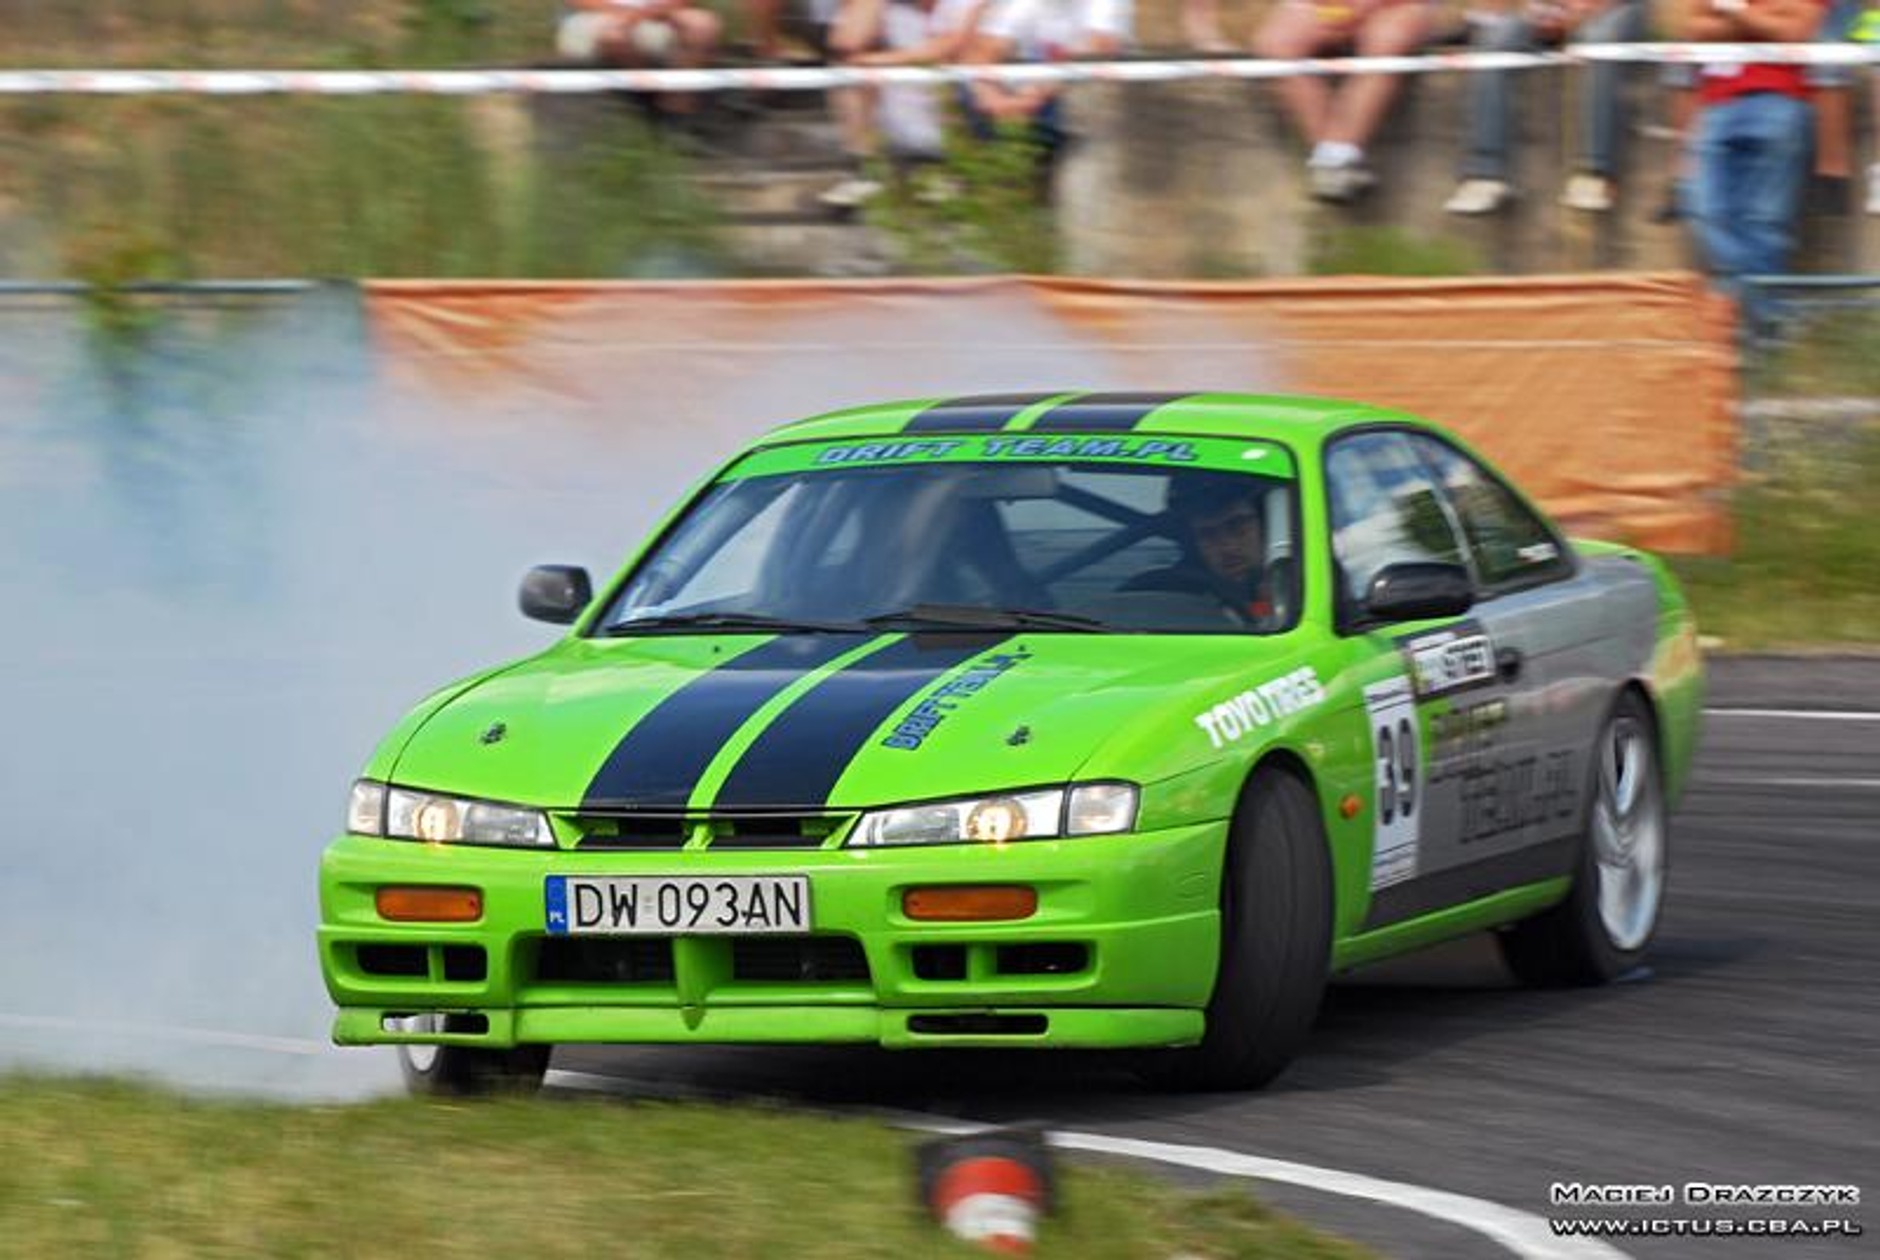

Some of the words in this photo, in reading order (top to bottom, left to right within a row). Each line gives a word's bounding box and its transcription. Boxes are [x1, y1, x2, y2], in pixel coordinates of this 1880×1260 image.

[817, 441, 961, 464] DRIFT
[986, 439, 1199, 462] TEAM.PL
[1194, 690, 1271, 748] TOYO
[1378, 718, 1416, 826] 39
[574, 884, 638, 927] DW
[657, 882, 801, 927] 093AN
